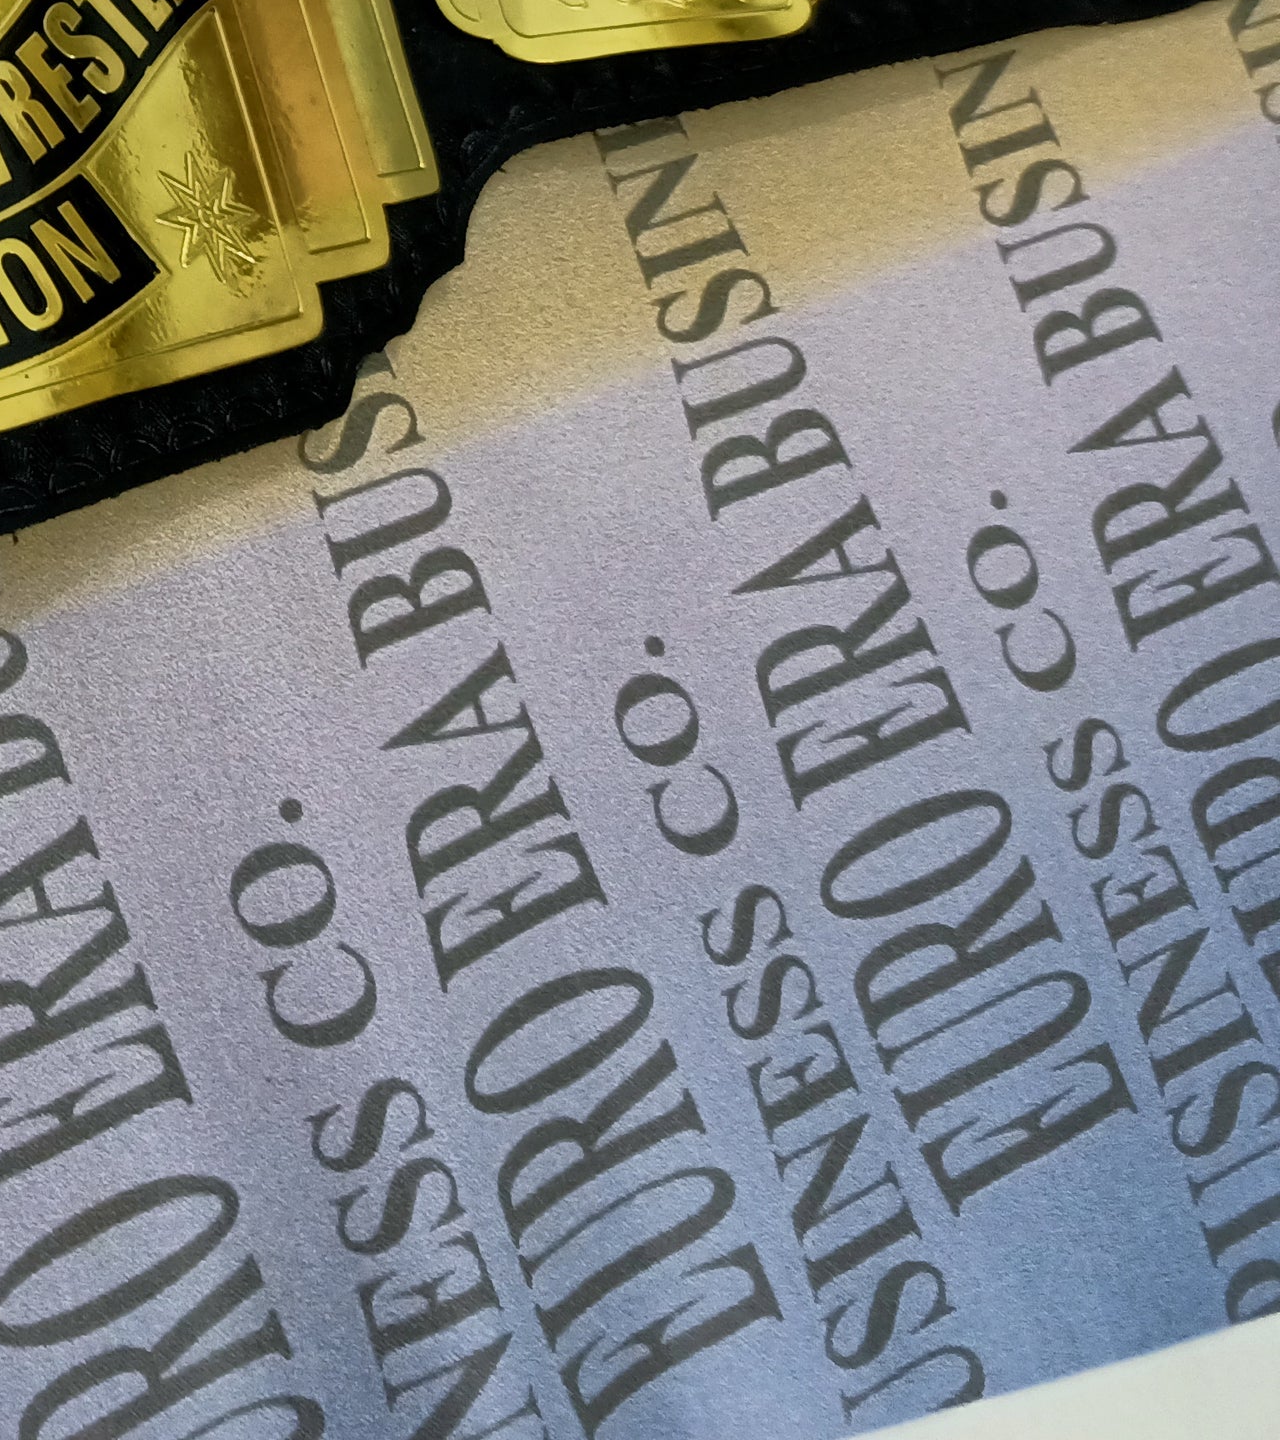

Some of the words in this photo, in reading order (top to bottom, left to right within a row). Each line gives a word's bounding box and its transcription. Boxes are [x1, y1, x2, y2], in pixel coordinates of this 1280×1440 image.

[732, 493, 974, 812] ERA
[965, 489, 1077, 693] CO.
[1066, 364, 1280, 653] ERA
[378, 640, 609, 994] ERA
[614, 634, 740, 857] CO.
[228, 797, 378, 1049] CO.
[820, 788, 1139, 1217] EURO
[463, 965, 785, 1440] EURO
